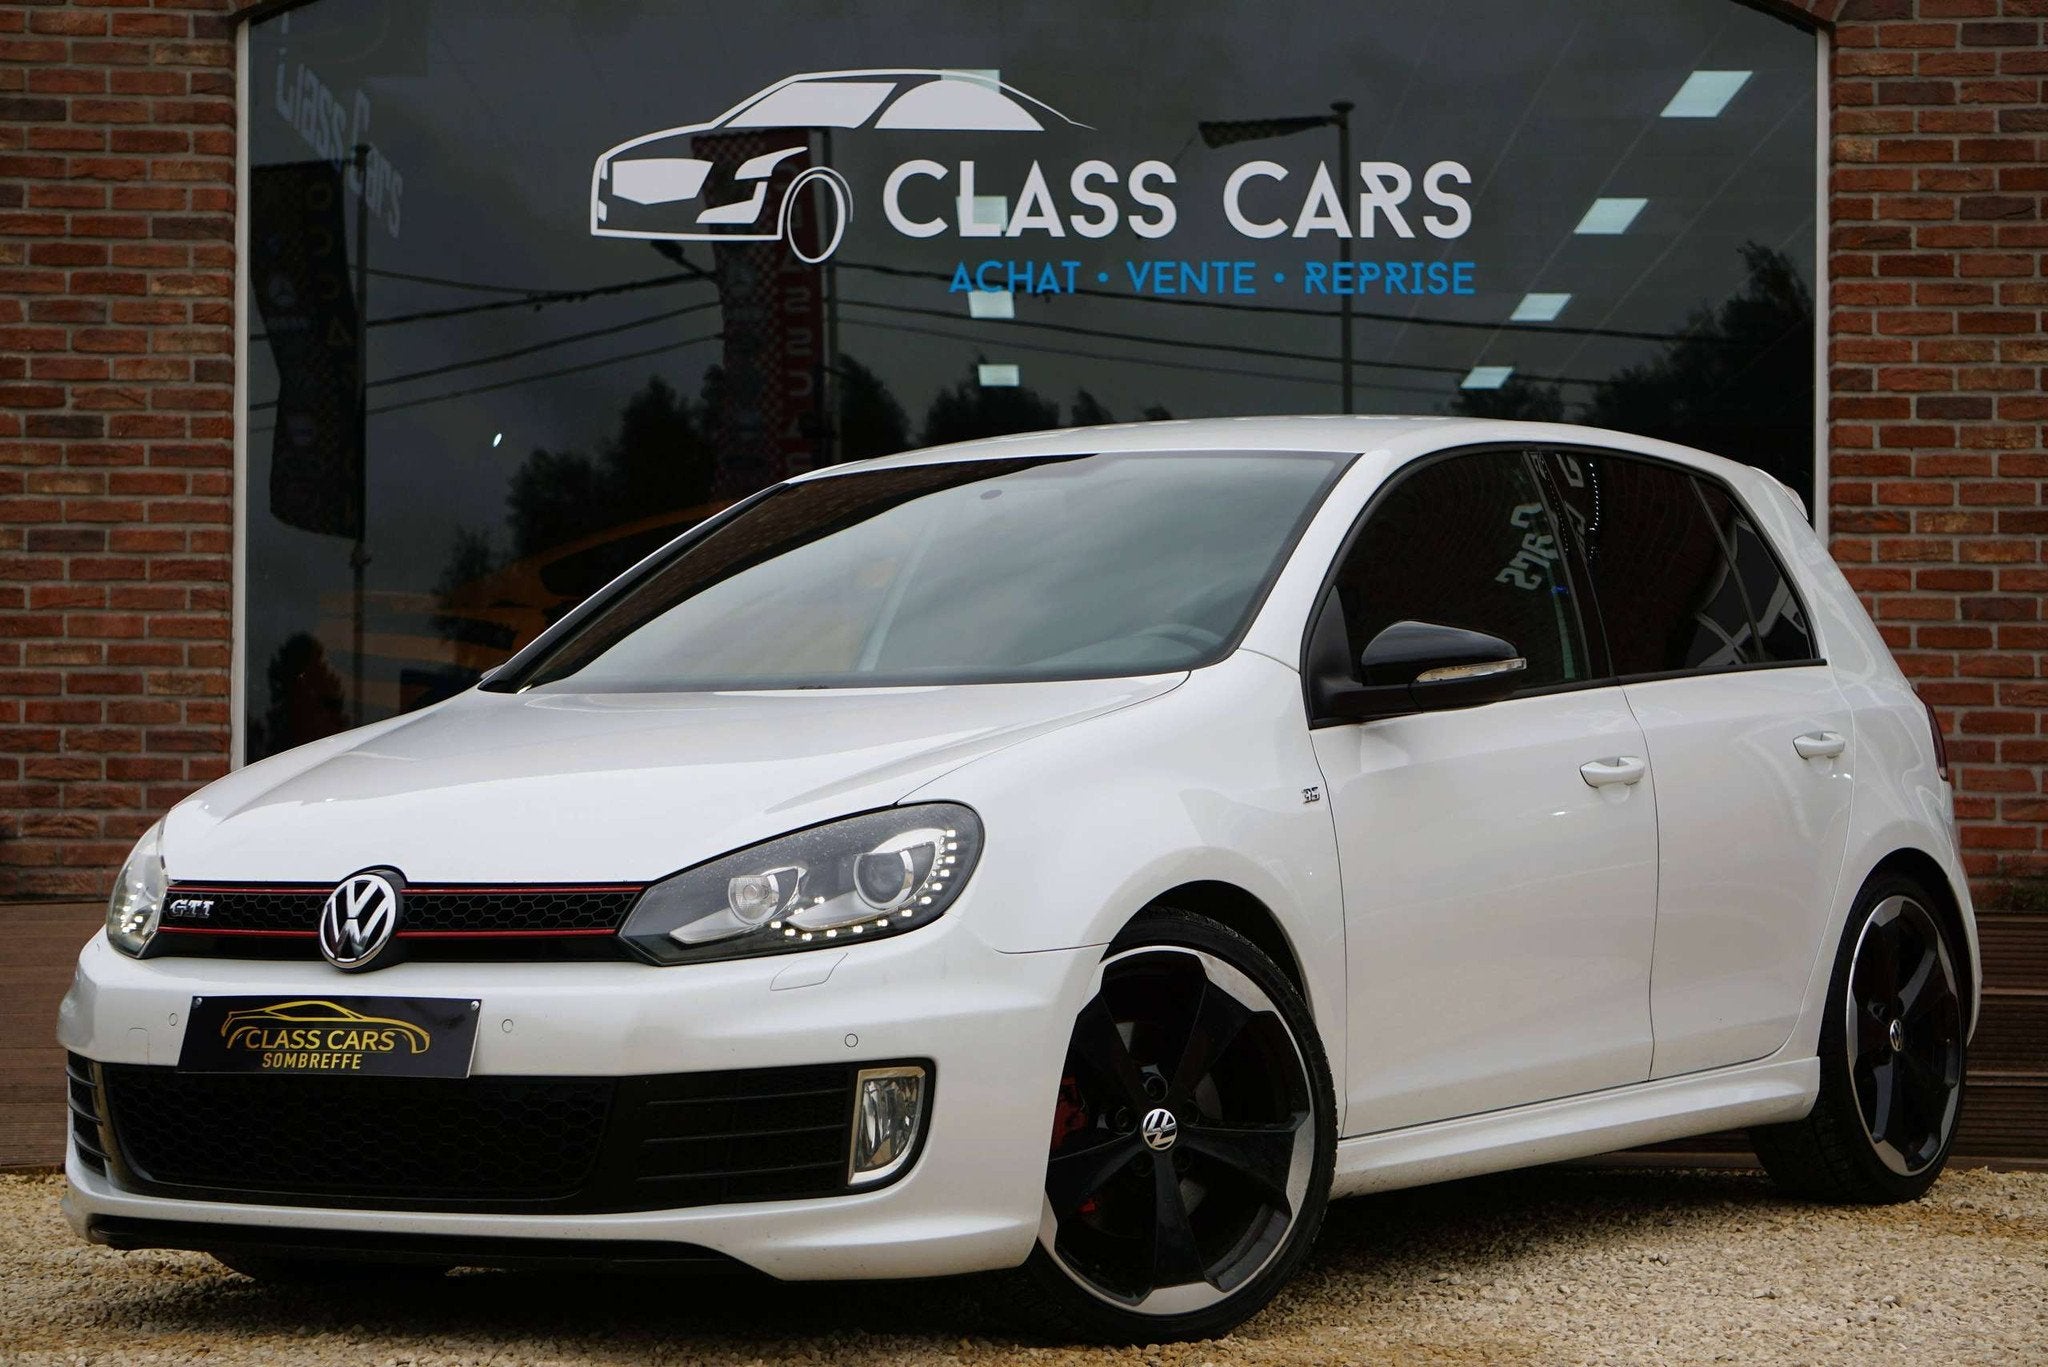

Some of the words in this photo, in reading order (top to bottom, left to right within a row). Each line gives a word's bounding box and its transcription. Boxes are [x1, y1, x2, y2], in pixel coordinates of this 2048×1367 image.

[884, 160, 1176, 237] CLASS
[1224, 161, 1473, 238] CARS
[950, 261, 1081, 293] ACHAT
[1126, 262, 1256, 294] VENTE
[1304, 262, 1475, 294] REPRISE
[170, 899, 214, 917] GTI
[245, 1029, 320, 1050] CLASS
[327, 1029, 396, 1051] CARS
[262, 1052, 362, 1070] SOMBREFFE
